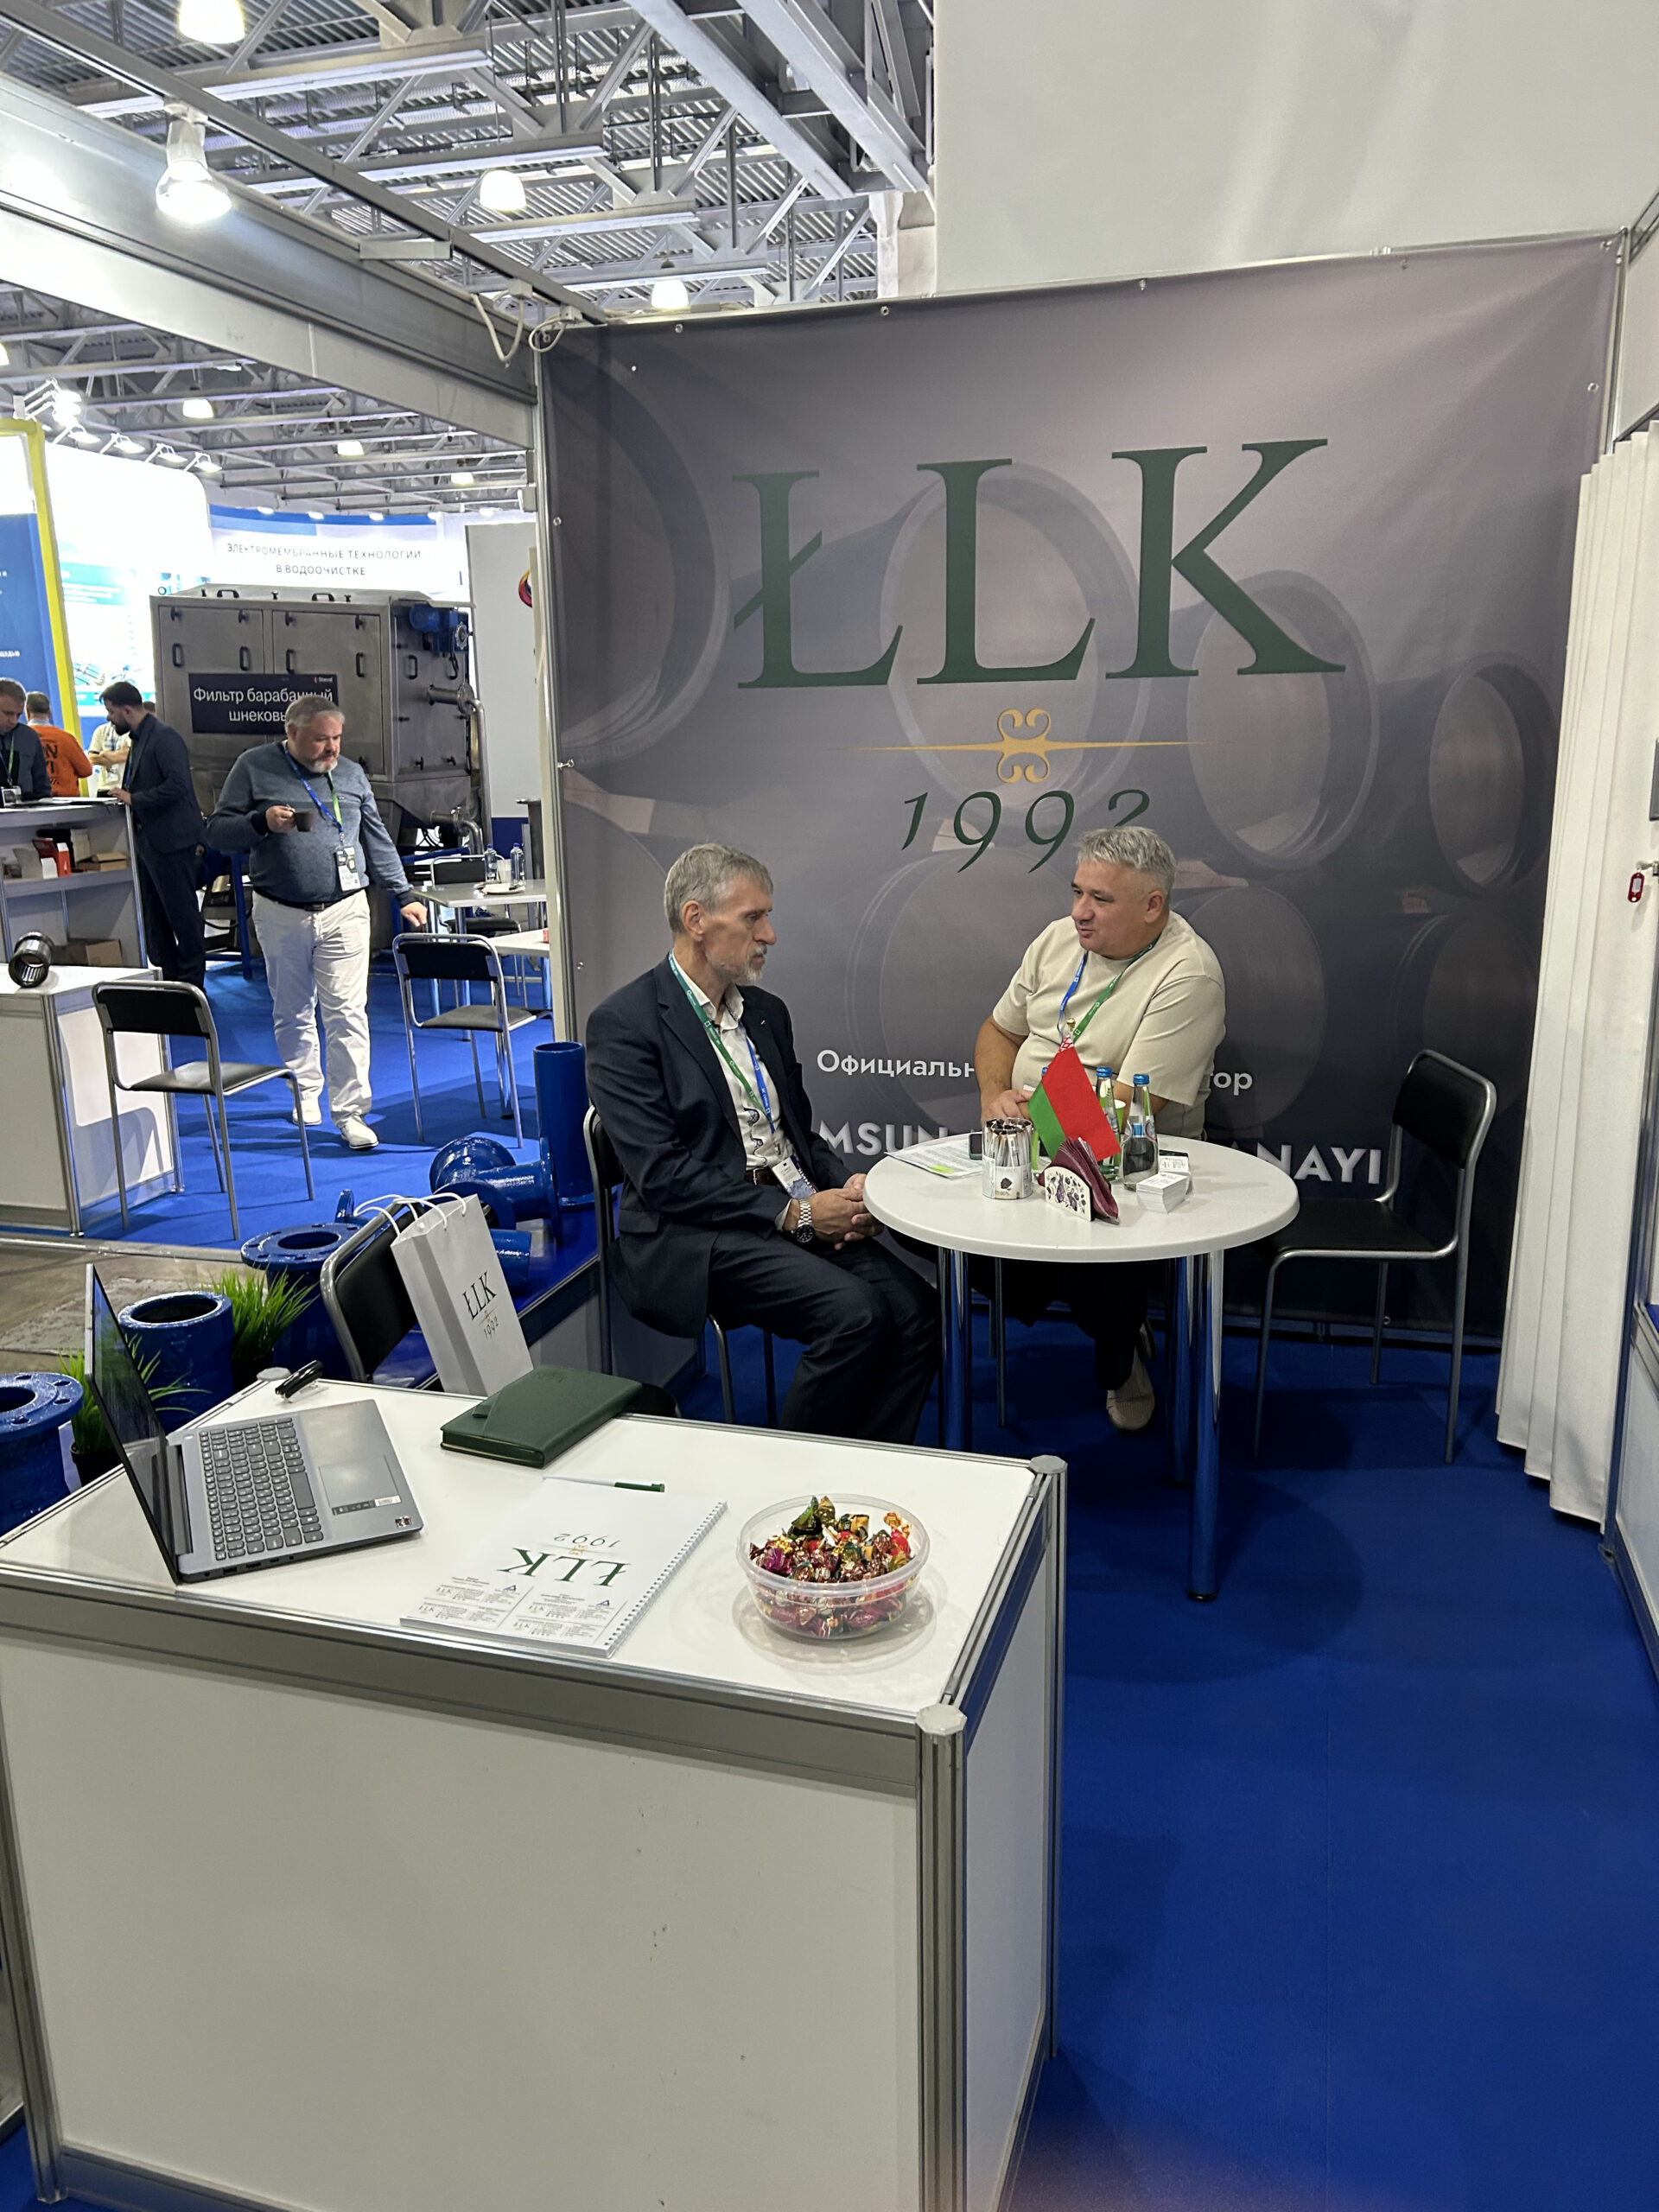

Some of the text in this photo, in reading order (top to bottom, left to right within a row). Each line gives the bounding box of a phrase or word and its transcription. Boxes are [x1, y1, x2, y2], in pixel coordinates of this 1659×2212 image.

[226, 543, 422, 560] ЭЛЕКТРОМЕМБРАННЫЕ ТЕХНОЛОГИИ
[276, 564, 365, 575] В ВОДООЧИСТКЕ
[193, 686, 244, 705] Фильтр
[228, 710, 287, 722] шнеков
[901, 788, 1151, 874] 1992
[817, 1049, 976, 1077] Официальн
[1230, 1141, 1382, 1185] NAYI
[483, 1315, 499, 1340] 1992
[553, 1533, 620, 1548] 1992
